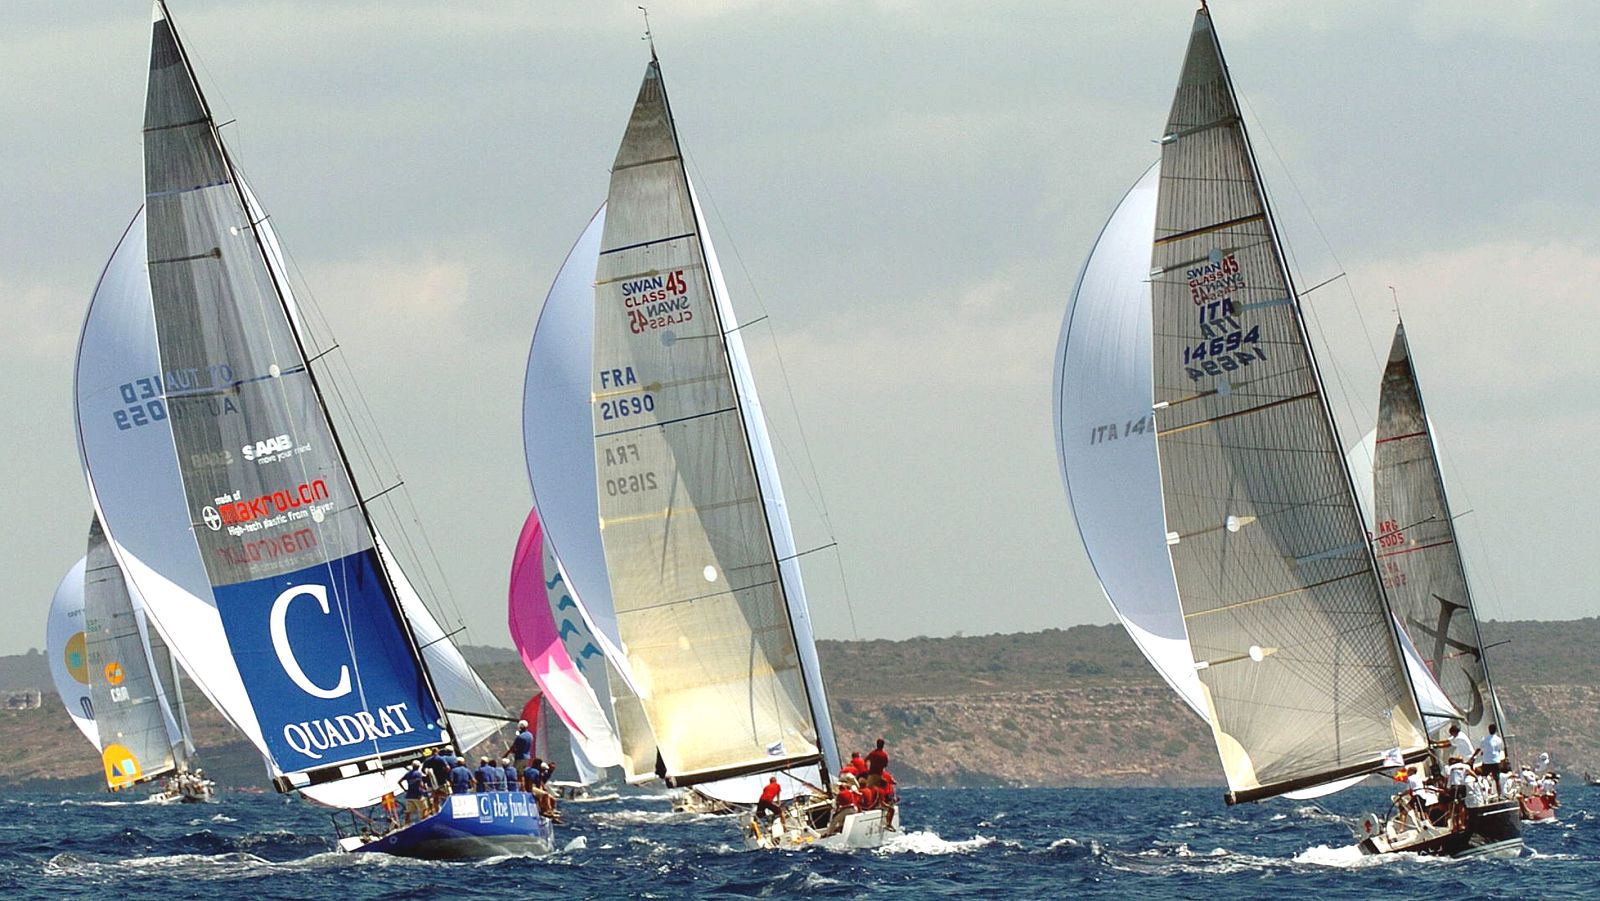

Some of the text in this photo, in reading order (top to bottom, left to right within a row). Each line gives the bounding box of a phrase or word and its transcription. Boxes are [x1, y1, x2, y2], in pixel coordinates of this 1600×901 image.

[1187, 261, 1221, 280] SWAN
[1222, 254, 1239, 275] 45
[622, 276, 663, 296] SWAN
[665, 270, 687, 295] 45
[1189, 271, 1223, 288] CLASS
[624, 289, 666, 308] CLASS
[1200, 298, 1233, 324] ITA
[1184, 325, 1259, 365] 14694
[600, 366, 637, 389] FRA
[600, 394, 655, 420] 21690
[1090, 423, 1118, 445] ITA
[242, 434, 293, 461] SAAB
[257, 454, 276, 465] move
[277, 449, 292, 463] your
[287, 510, 309, 522] from
[309, 501, 335, 519] Byer
[1379, 519, 1398, 534] ARG
[269, 584, 352, 699] C
[283, 703, 415, 759] QUADRAT
[493, 793, 508, 817] the
[509, 793, 529, 823] fund
